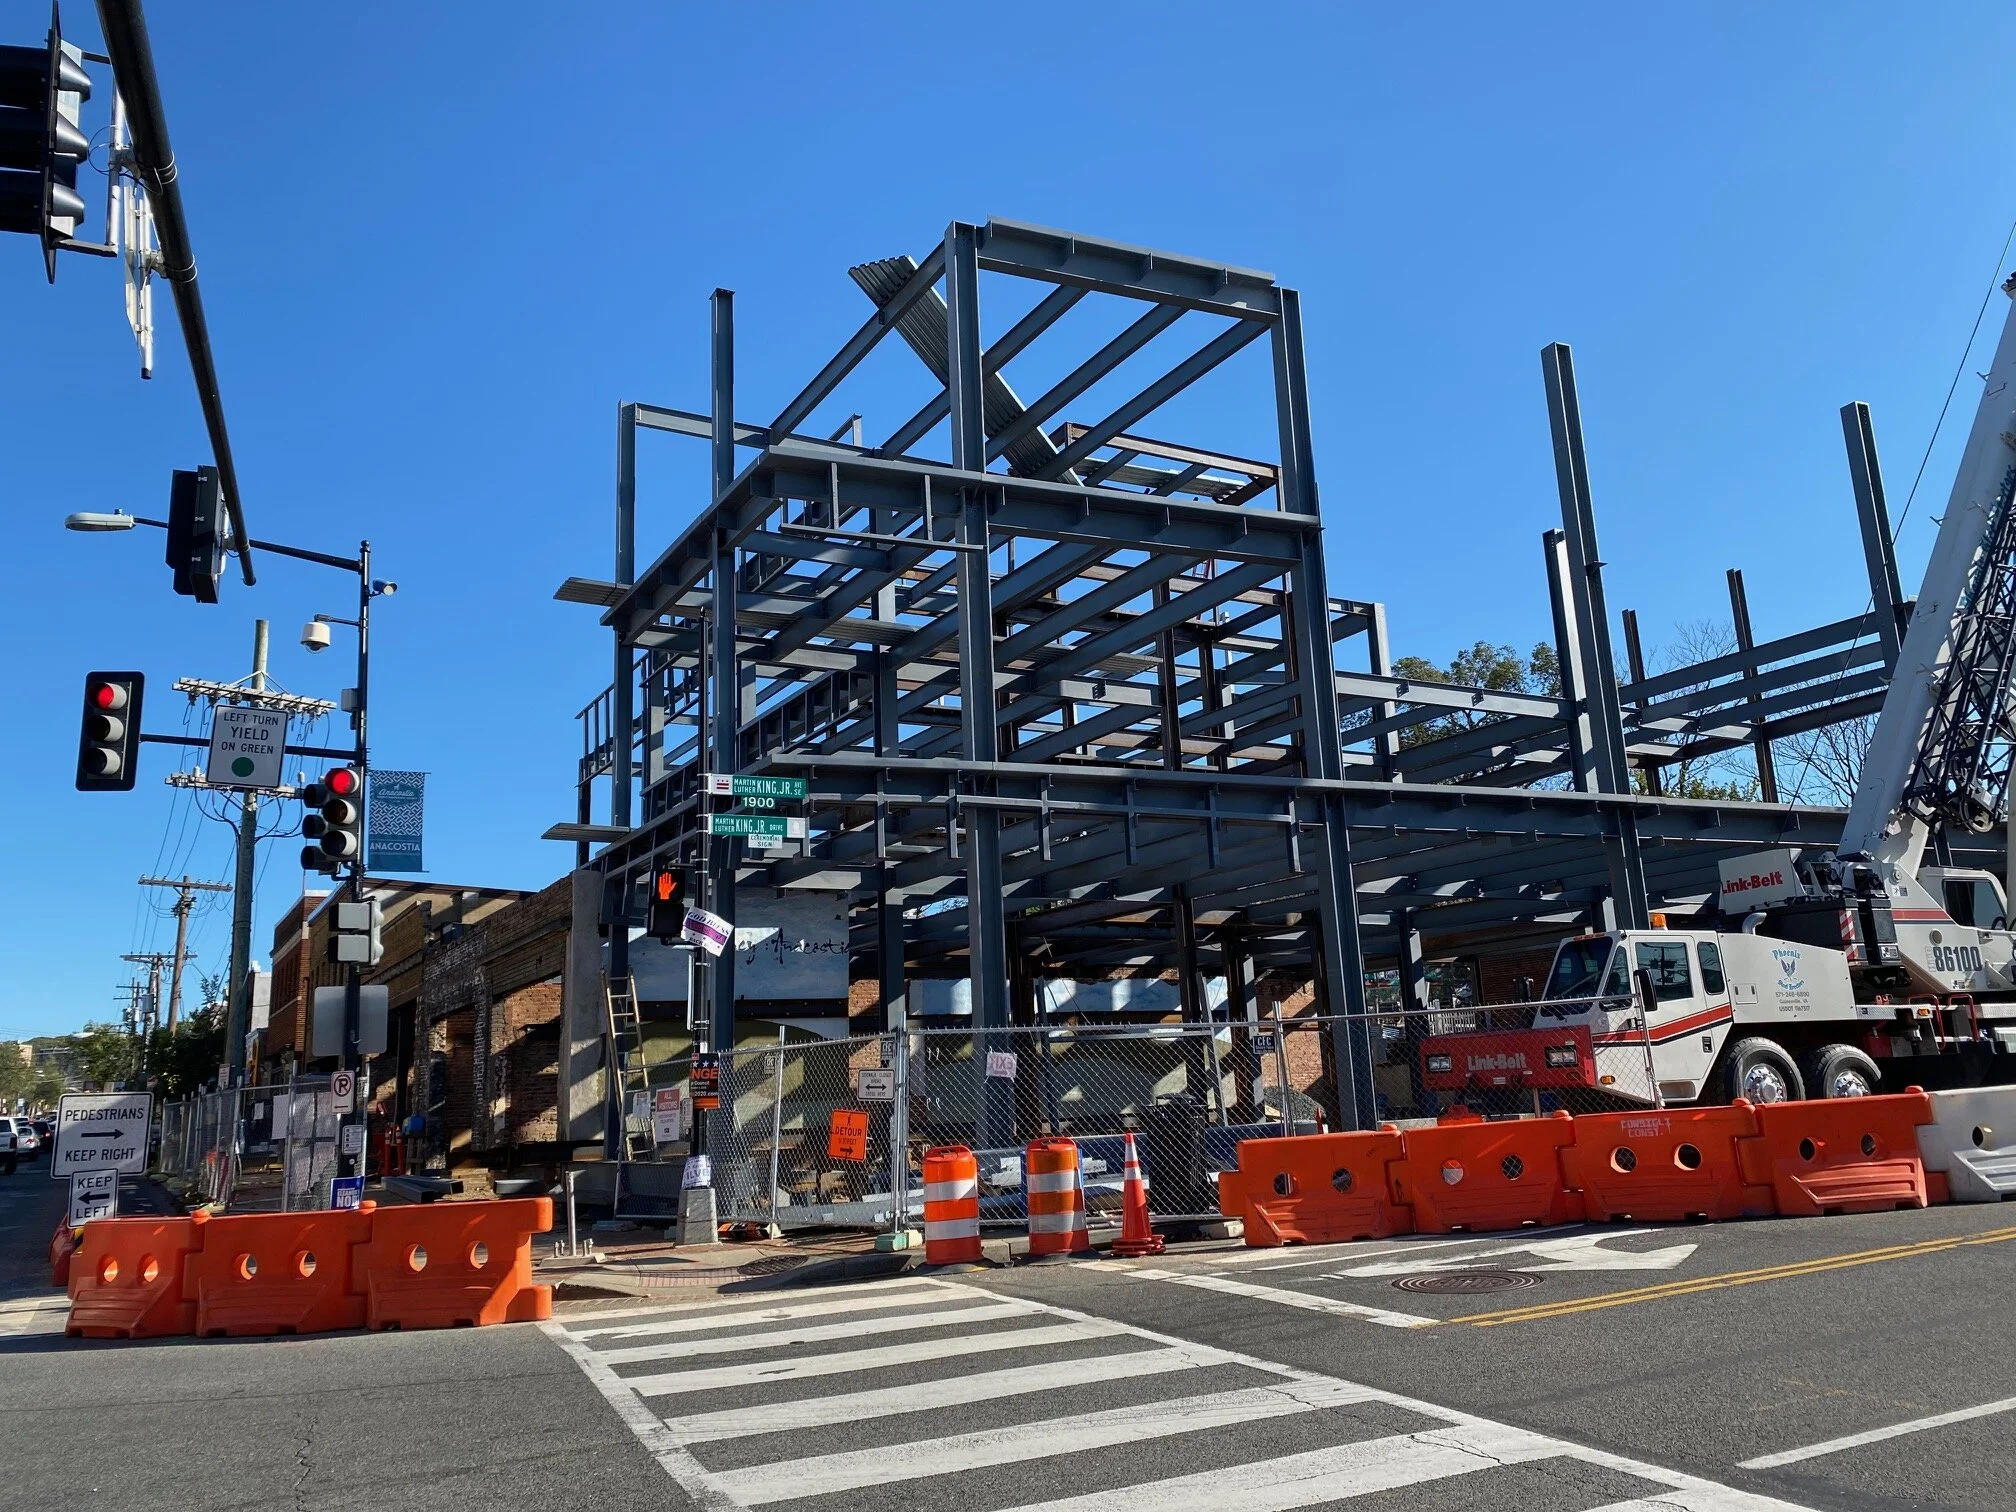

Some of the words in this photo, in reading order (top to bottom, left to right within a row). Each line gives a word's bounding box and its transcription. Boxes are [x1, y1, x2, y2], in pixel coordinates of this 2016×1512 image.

[223, 712, 247, 723] LEFT
[252, 714, 279, 726] TURN
[231, 726, 269, 741] YIELD
[221, 741, 236, 751] ON
[240, 743, 274, 754] GREEN
[733, 778, 756, 786] MARTIN
[733, 785, 757, 793] LUTHER
[742, 796, 775, 808] 1900
[714, 817, 735, 825] MARTIN
[769, 824, 783, 832] DRIVE
[369, 842, 420, 851] ANACOSTIA
[1932, 946, 1983, 971] 86100
[1467, 1052, 1528, 1071] Link-Belt
[65, 1108, 144, 1121] PEDESTRIANS
[835, 1126, 863, 1136] DETOUR
[65, 1149, 97, 1161] KEEP
[101, 1148, 136, 1160] RIGHT
[77, 1176, 113, 1189] KEEP
[76, 1205, 109, 1219] LEFT
